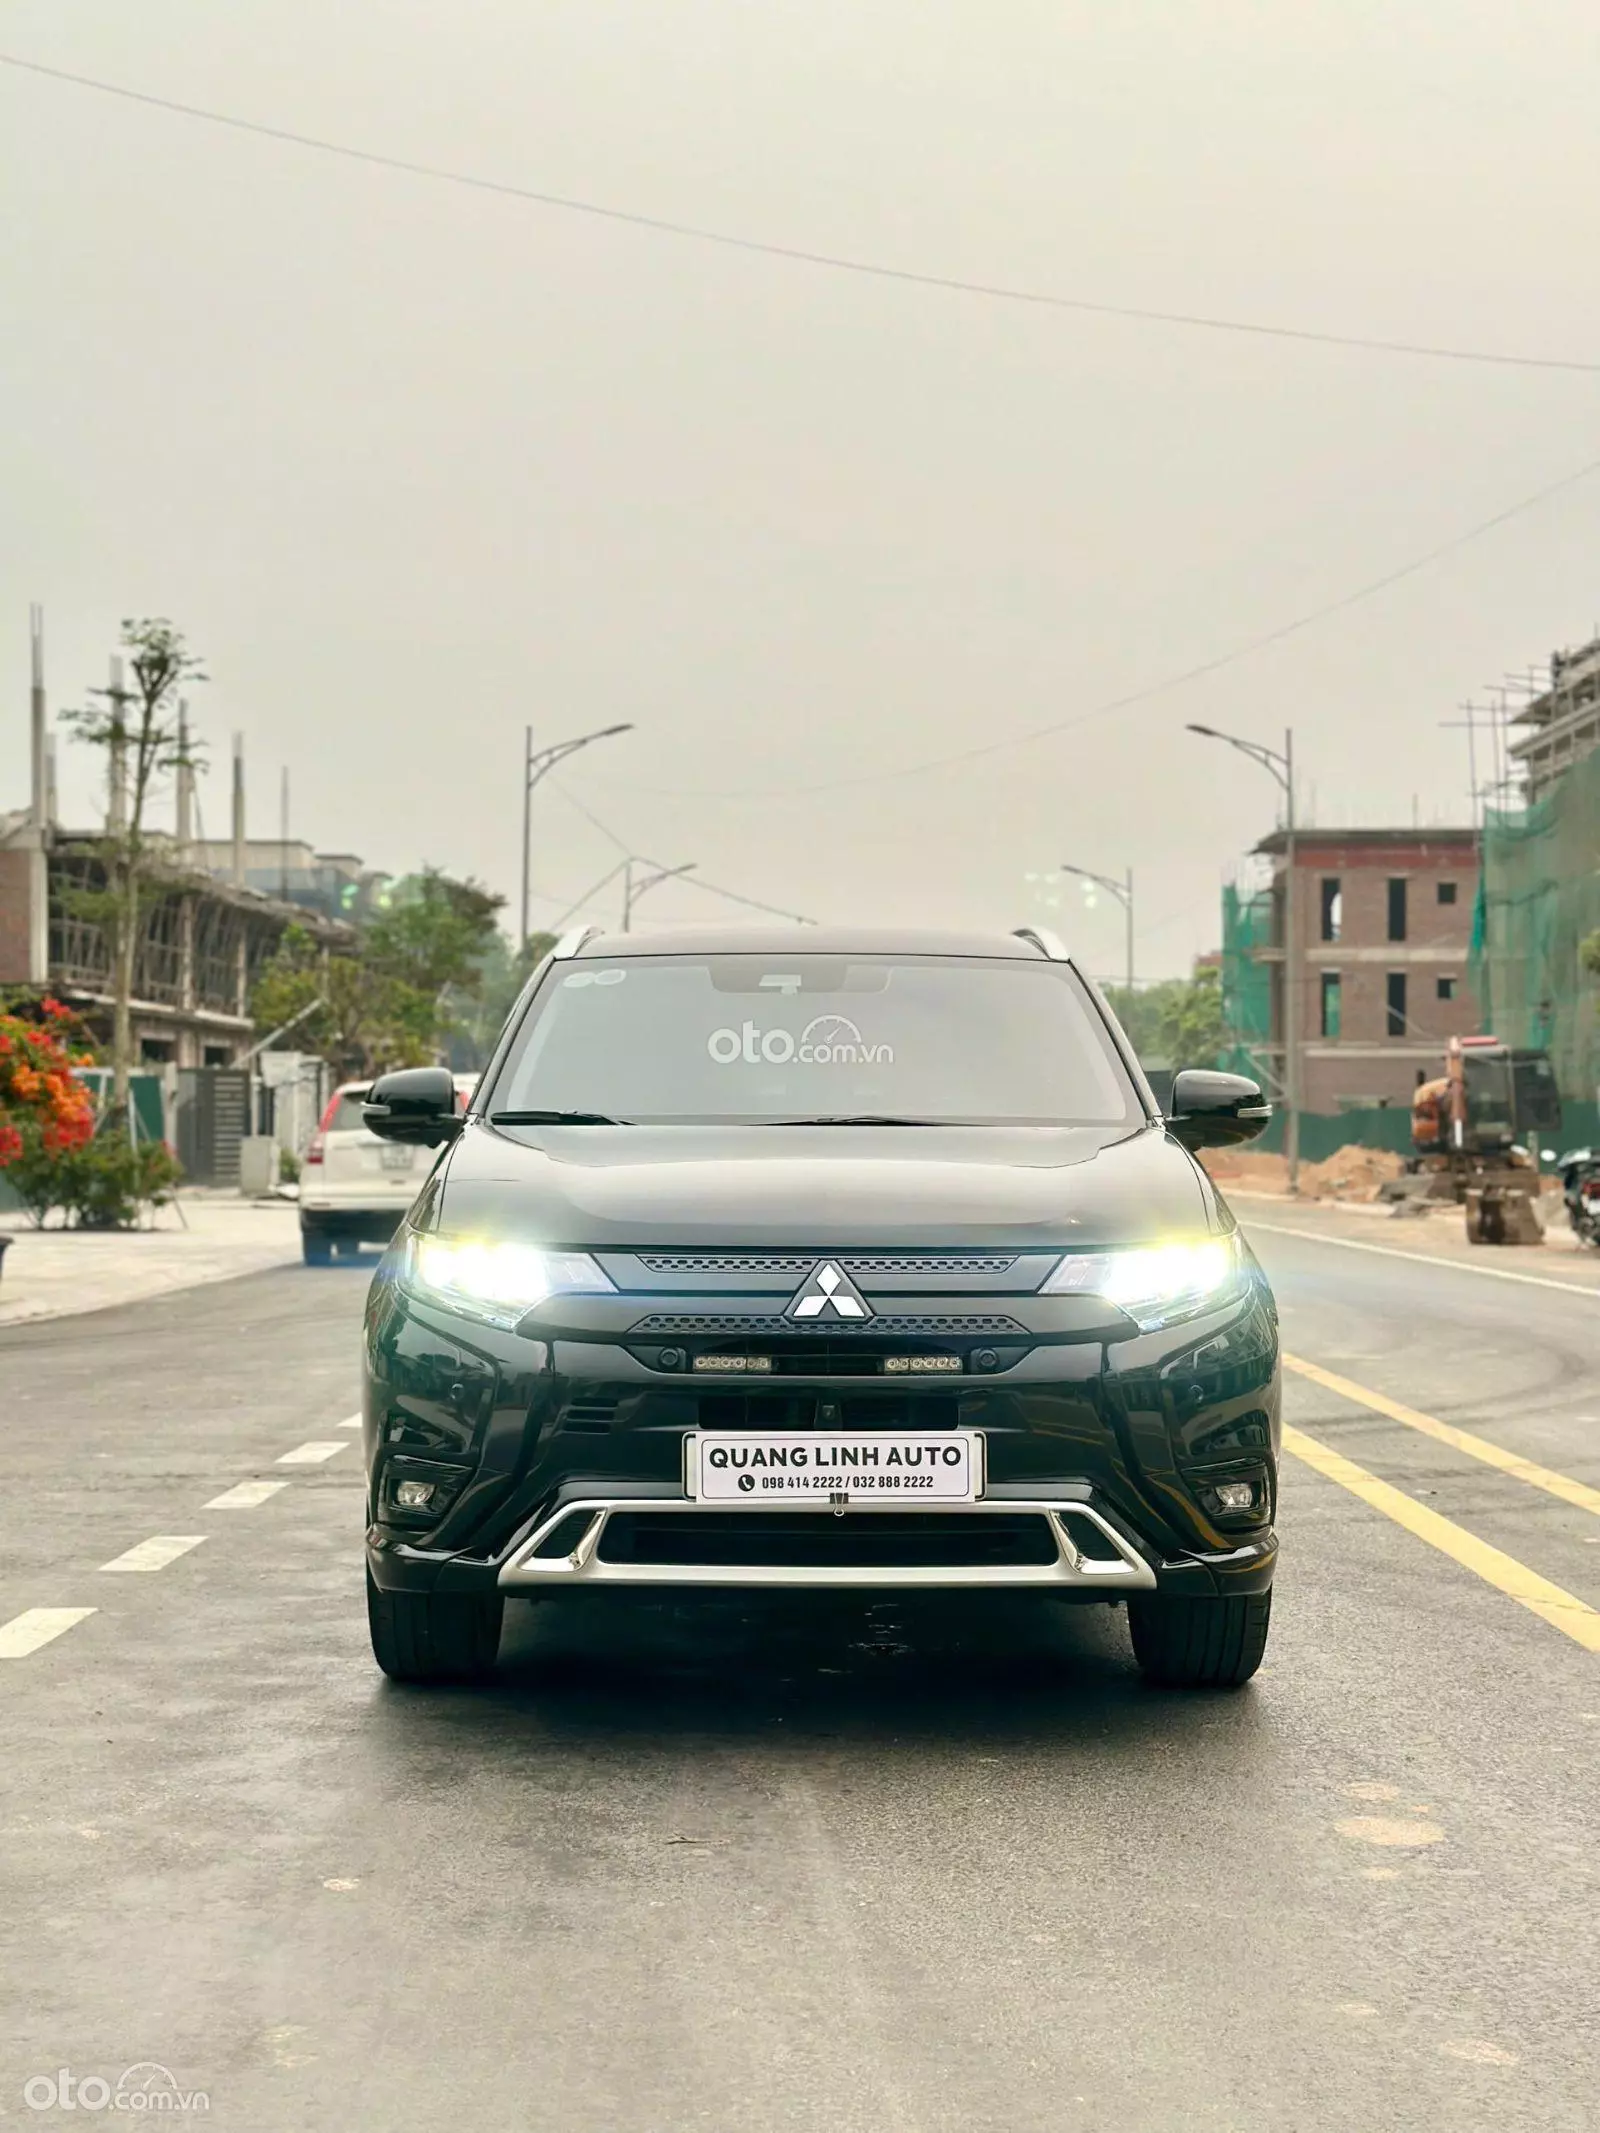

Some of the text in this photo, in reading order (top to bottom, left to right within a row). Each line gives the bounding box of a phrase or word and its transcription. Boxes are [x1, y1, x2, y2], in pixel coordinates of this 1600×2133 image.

[709, 1446, 962, 1469] QUANG LINH AUTO
[762, 1475, 934, 1489] 098 414 2222 / 032 888 2222
